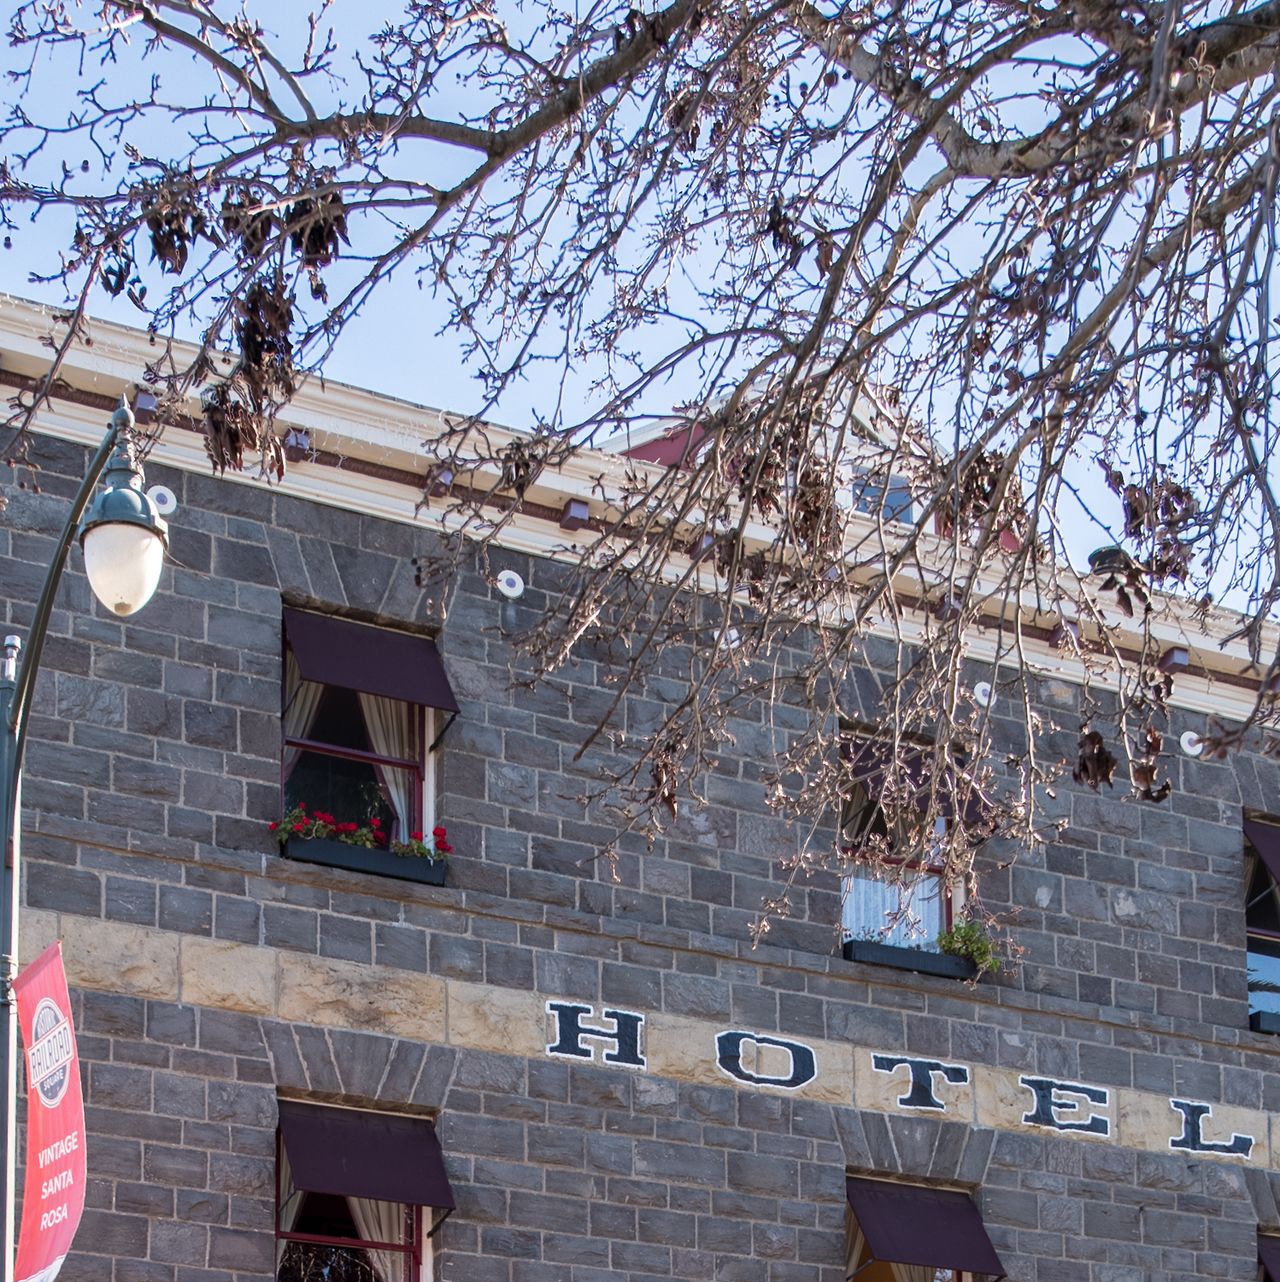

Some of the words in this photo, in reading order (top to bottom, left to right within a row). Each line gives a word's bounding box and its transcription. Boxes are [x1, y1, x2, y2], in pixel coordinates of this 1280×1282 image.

[31, 1026, 71, 1082] RAILROAD
[546, 1000, 1254, 1160] HOTEL
[38, 1131, 78, 1168] VINTAGE
[41, 1169, 73, 1199] SANTA
[40, 1203, 68, 1231] ROSA
